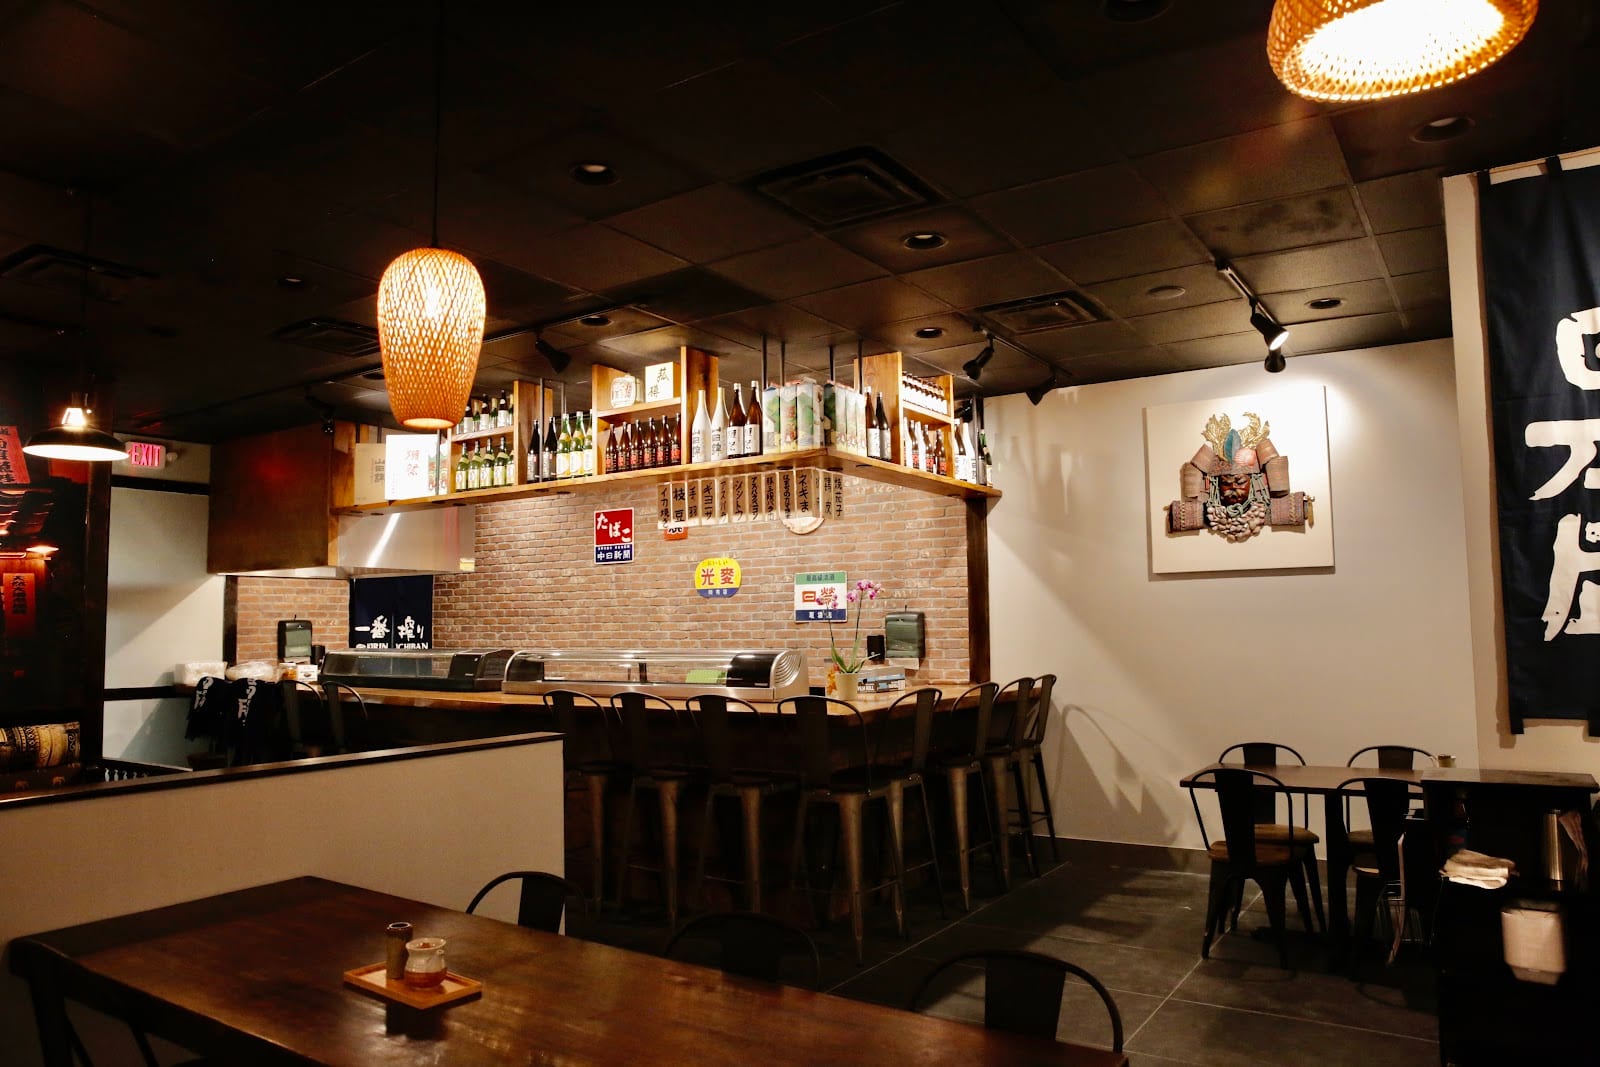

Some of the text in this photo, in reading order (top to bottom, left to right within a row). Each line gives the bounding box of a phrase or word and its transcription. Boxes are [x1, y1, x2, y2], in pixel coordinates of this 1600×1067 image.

[131, 442, 162, 467] EXIT
[673, 488, 686, 523] 枝豆
[735, 480, 744, 521] シシトウ
[798, 473, 809, 513] ネギま
[596, 512, 632, 542] たばこ
[354, 614, 424, 642] 一番搾り
